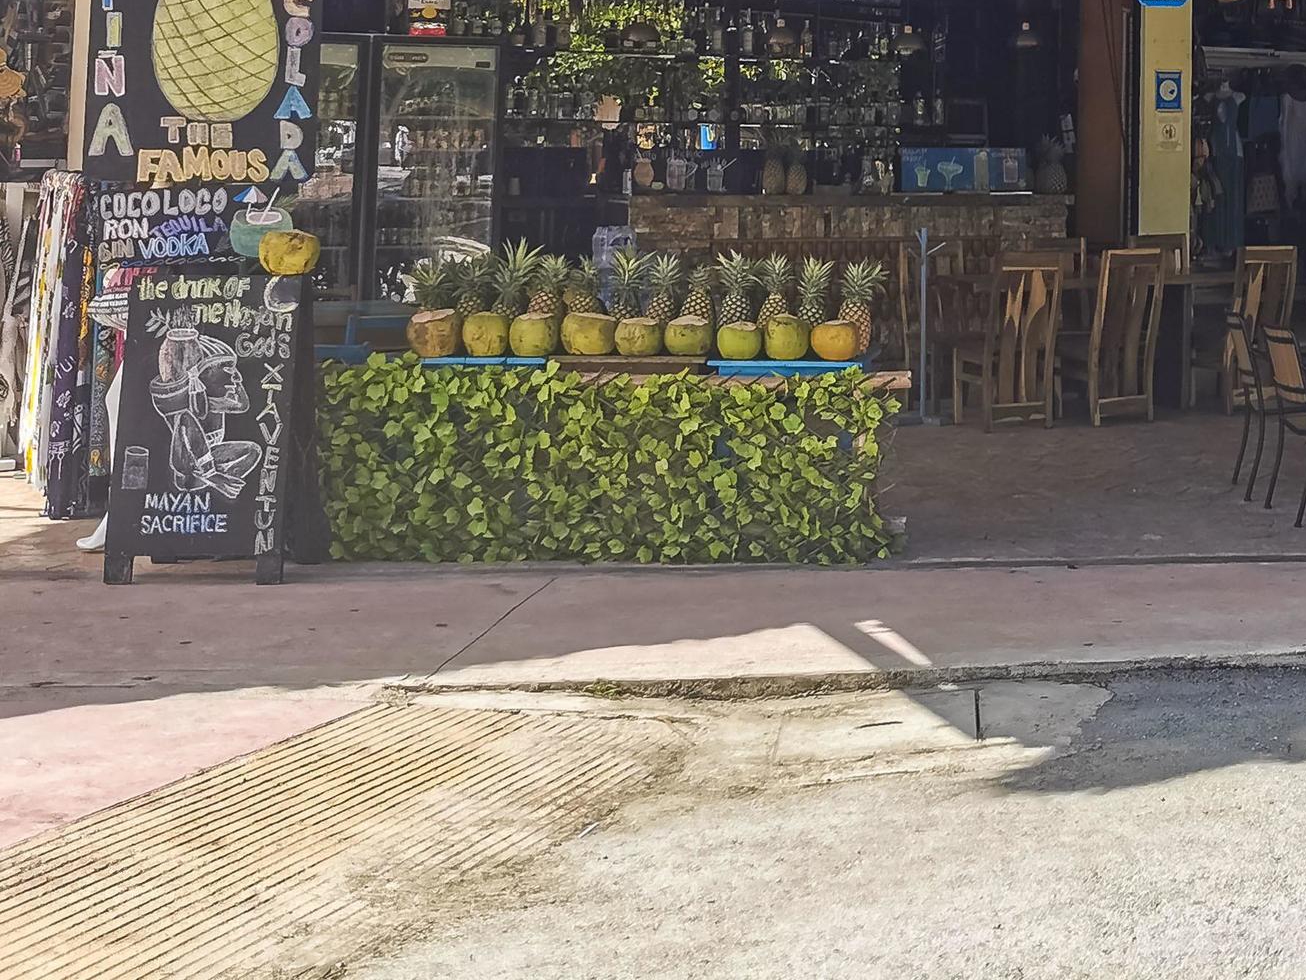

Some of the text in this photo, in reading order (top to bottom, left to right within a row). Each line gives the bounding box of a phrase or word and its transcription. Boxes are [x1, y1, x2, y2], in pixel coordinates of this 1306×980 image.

[137, 146, 270, 183] FAMOUS
[100, 187, 228, 220] COCO LOCO
[103, 214, 229, 240] RON TEQUILA
[138, 232, 210, 259] VODKA
[144, 492, 210, 512] MAYAN
[140, 513, 228, 534] SACRIFICE
